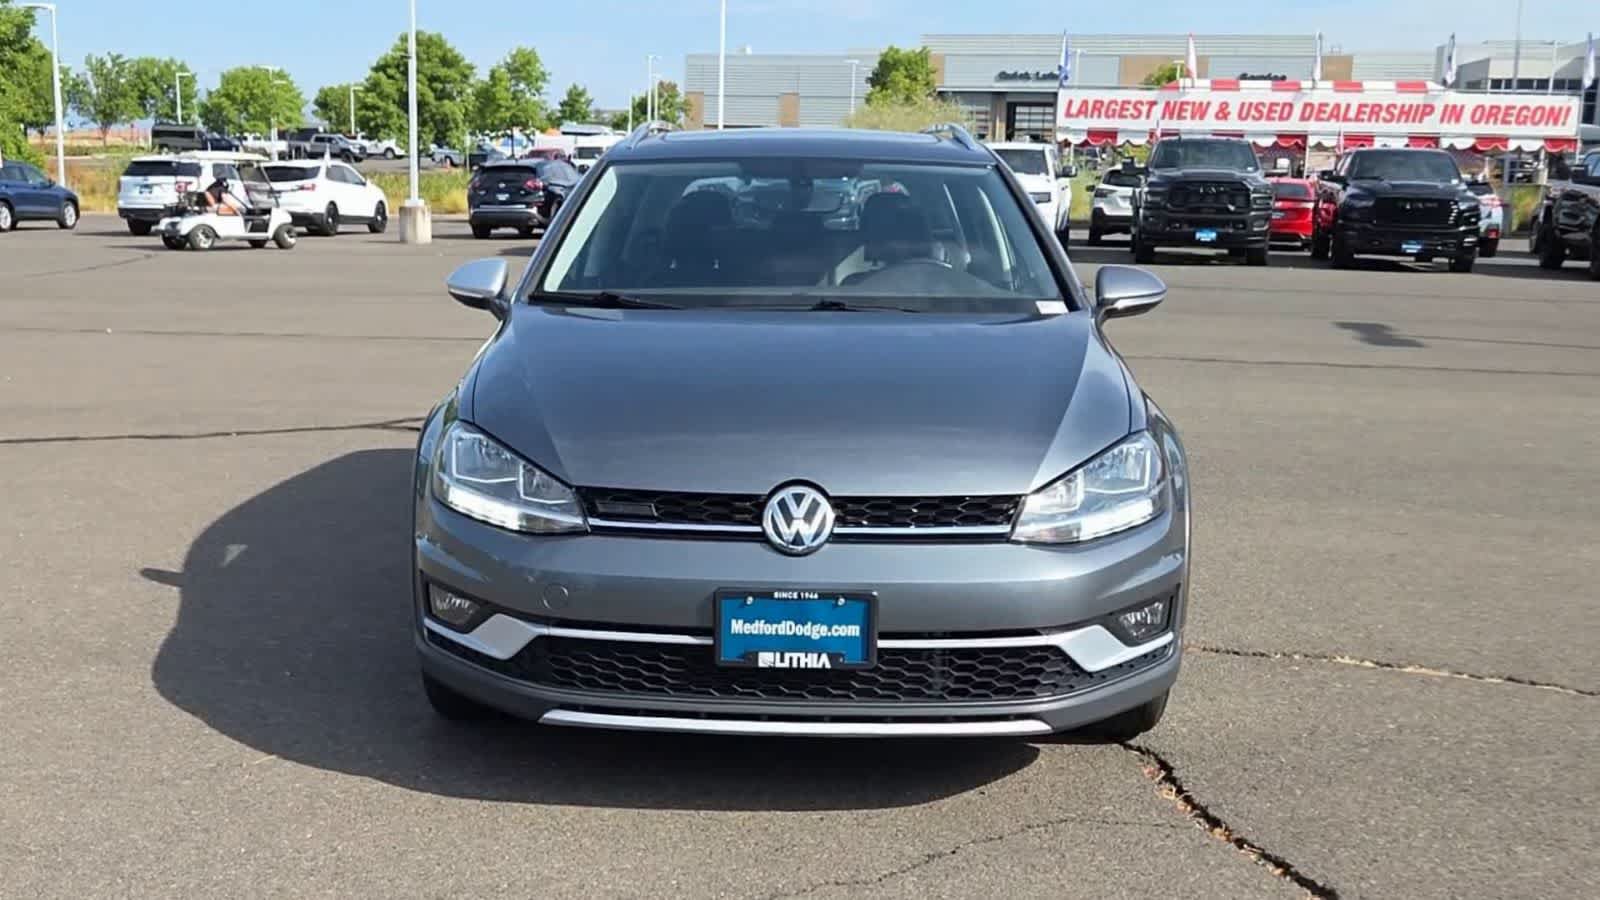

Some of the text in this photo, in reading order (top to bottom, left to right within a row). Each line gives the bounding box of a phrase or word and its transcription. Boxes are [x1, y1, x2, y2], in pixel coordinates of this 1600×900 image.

[1064, 99, 1571, 126] LARGEST NEW & USED DEALERSHIP IN OREGON!
[766, 486, 831, 548] VW
[773, 591, 798, 599] SINCE
[731, 619, 860, 640] MedfordDodge.com
[775, 652, 831, 669] LITHIA
